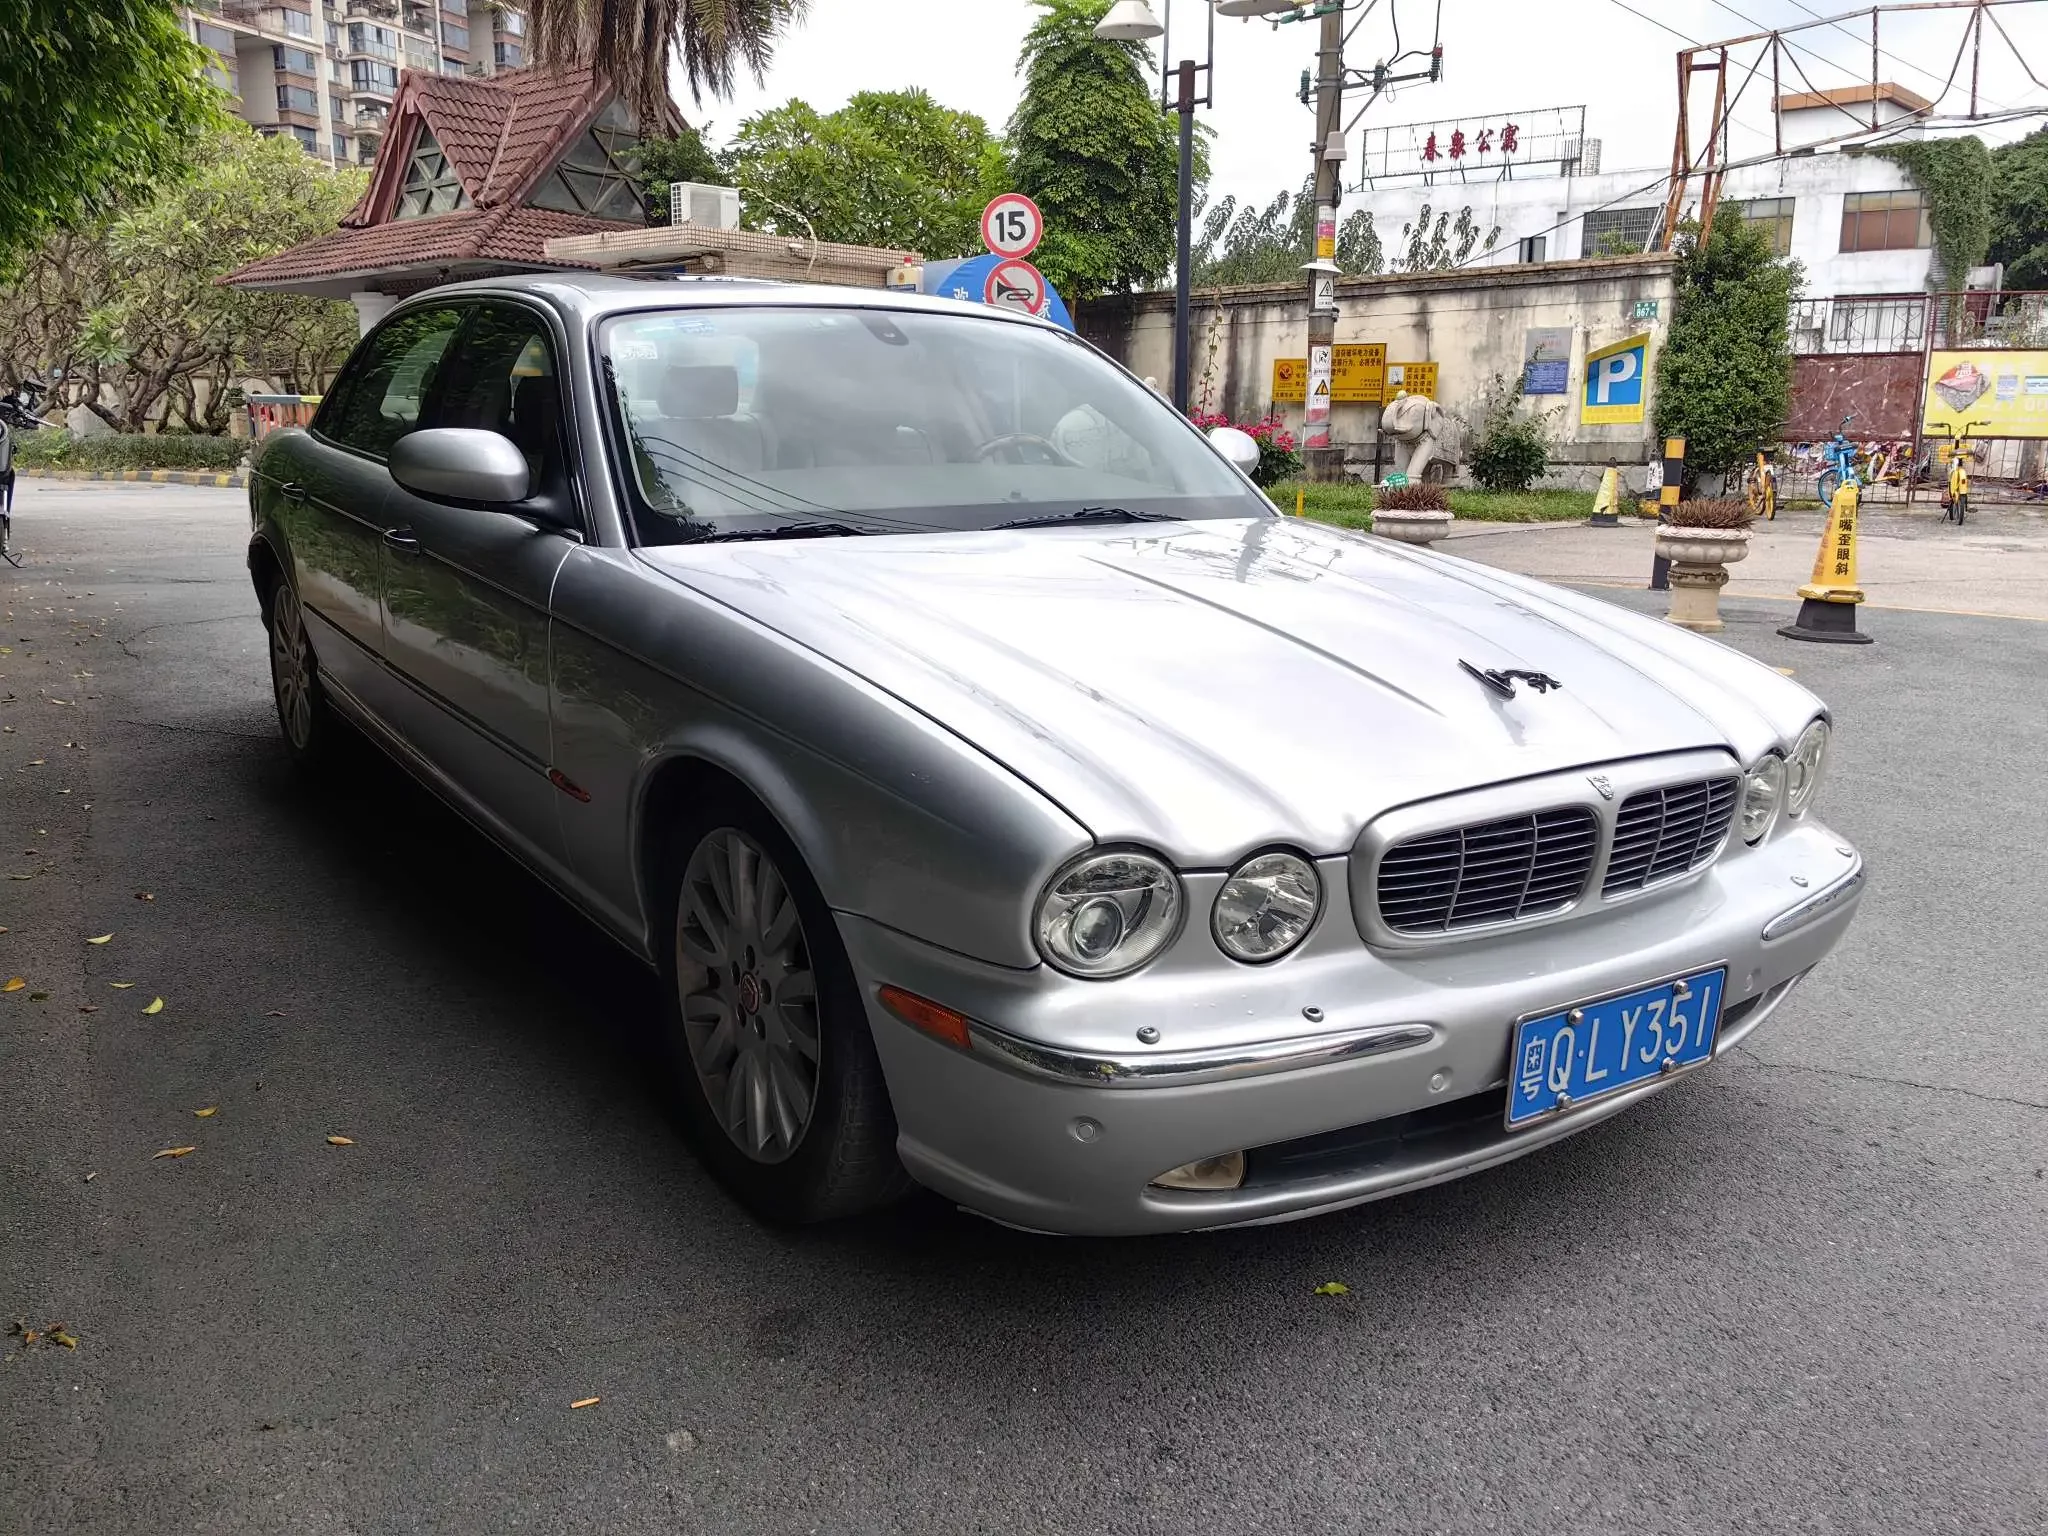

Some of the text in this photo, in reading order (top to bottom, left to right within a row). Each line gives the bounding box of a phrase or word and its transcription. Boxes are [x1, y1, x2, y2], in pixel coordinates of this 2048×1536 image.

[995, 211, 1026, 242] 15
[1597, 352, 1637, 403] P
[1835, 519, 1852, 576] 嘴歪眼斜
[1519, 986, 1711, 1101] 粤Q·LY351
